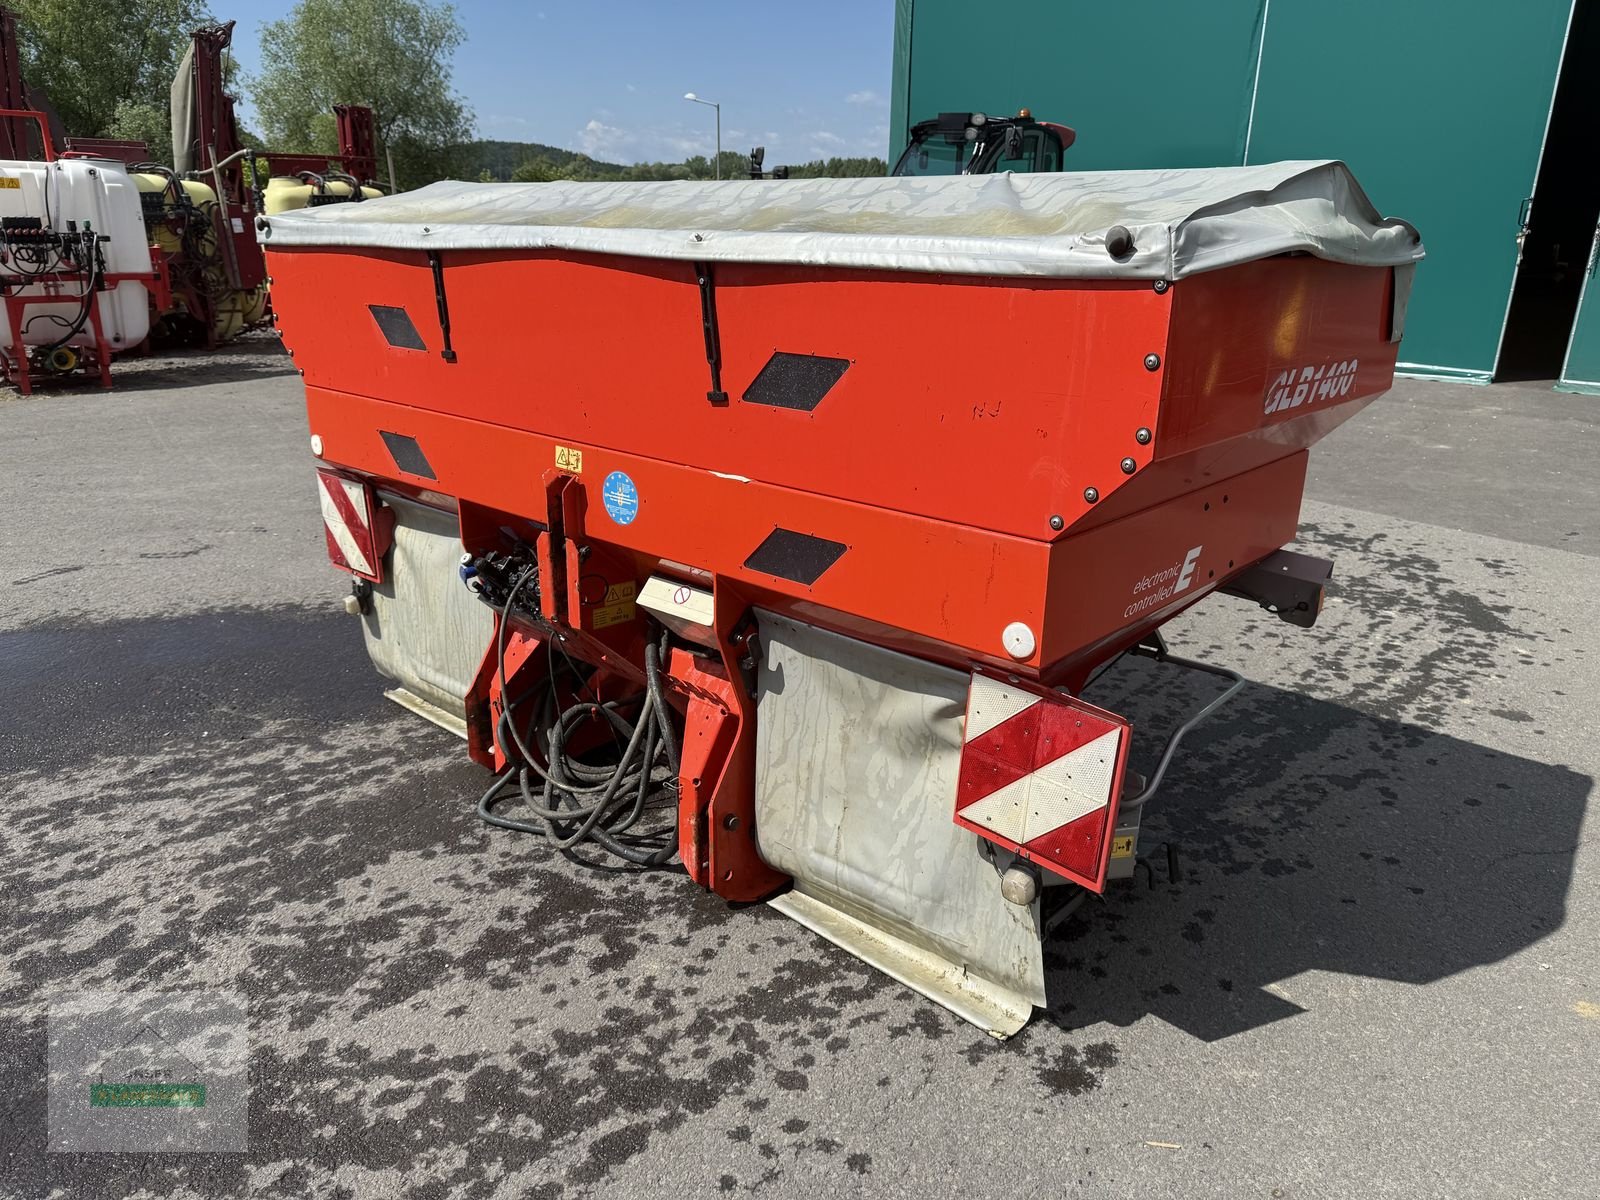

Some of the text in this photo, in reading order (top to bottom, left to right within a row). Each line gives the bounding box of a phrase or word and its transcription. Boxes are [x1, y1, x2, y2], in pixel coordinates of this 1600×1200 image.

[1133, 562, 1182, 595] electronic
[1173, 545, 1203, 594] E
[1123, 580, 1176, 618] controlled
